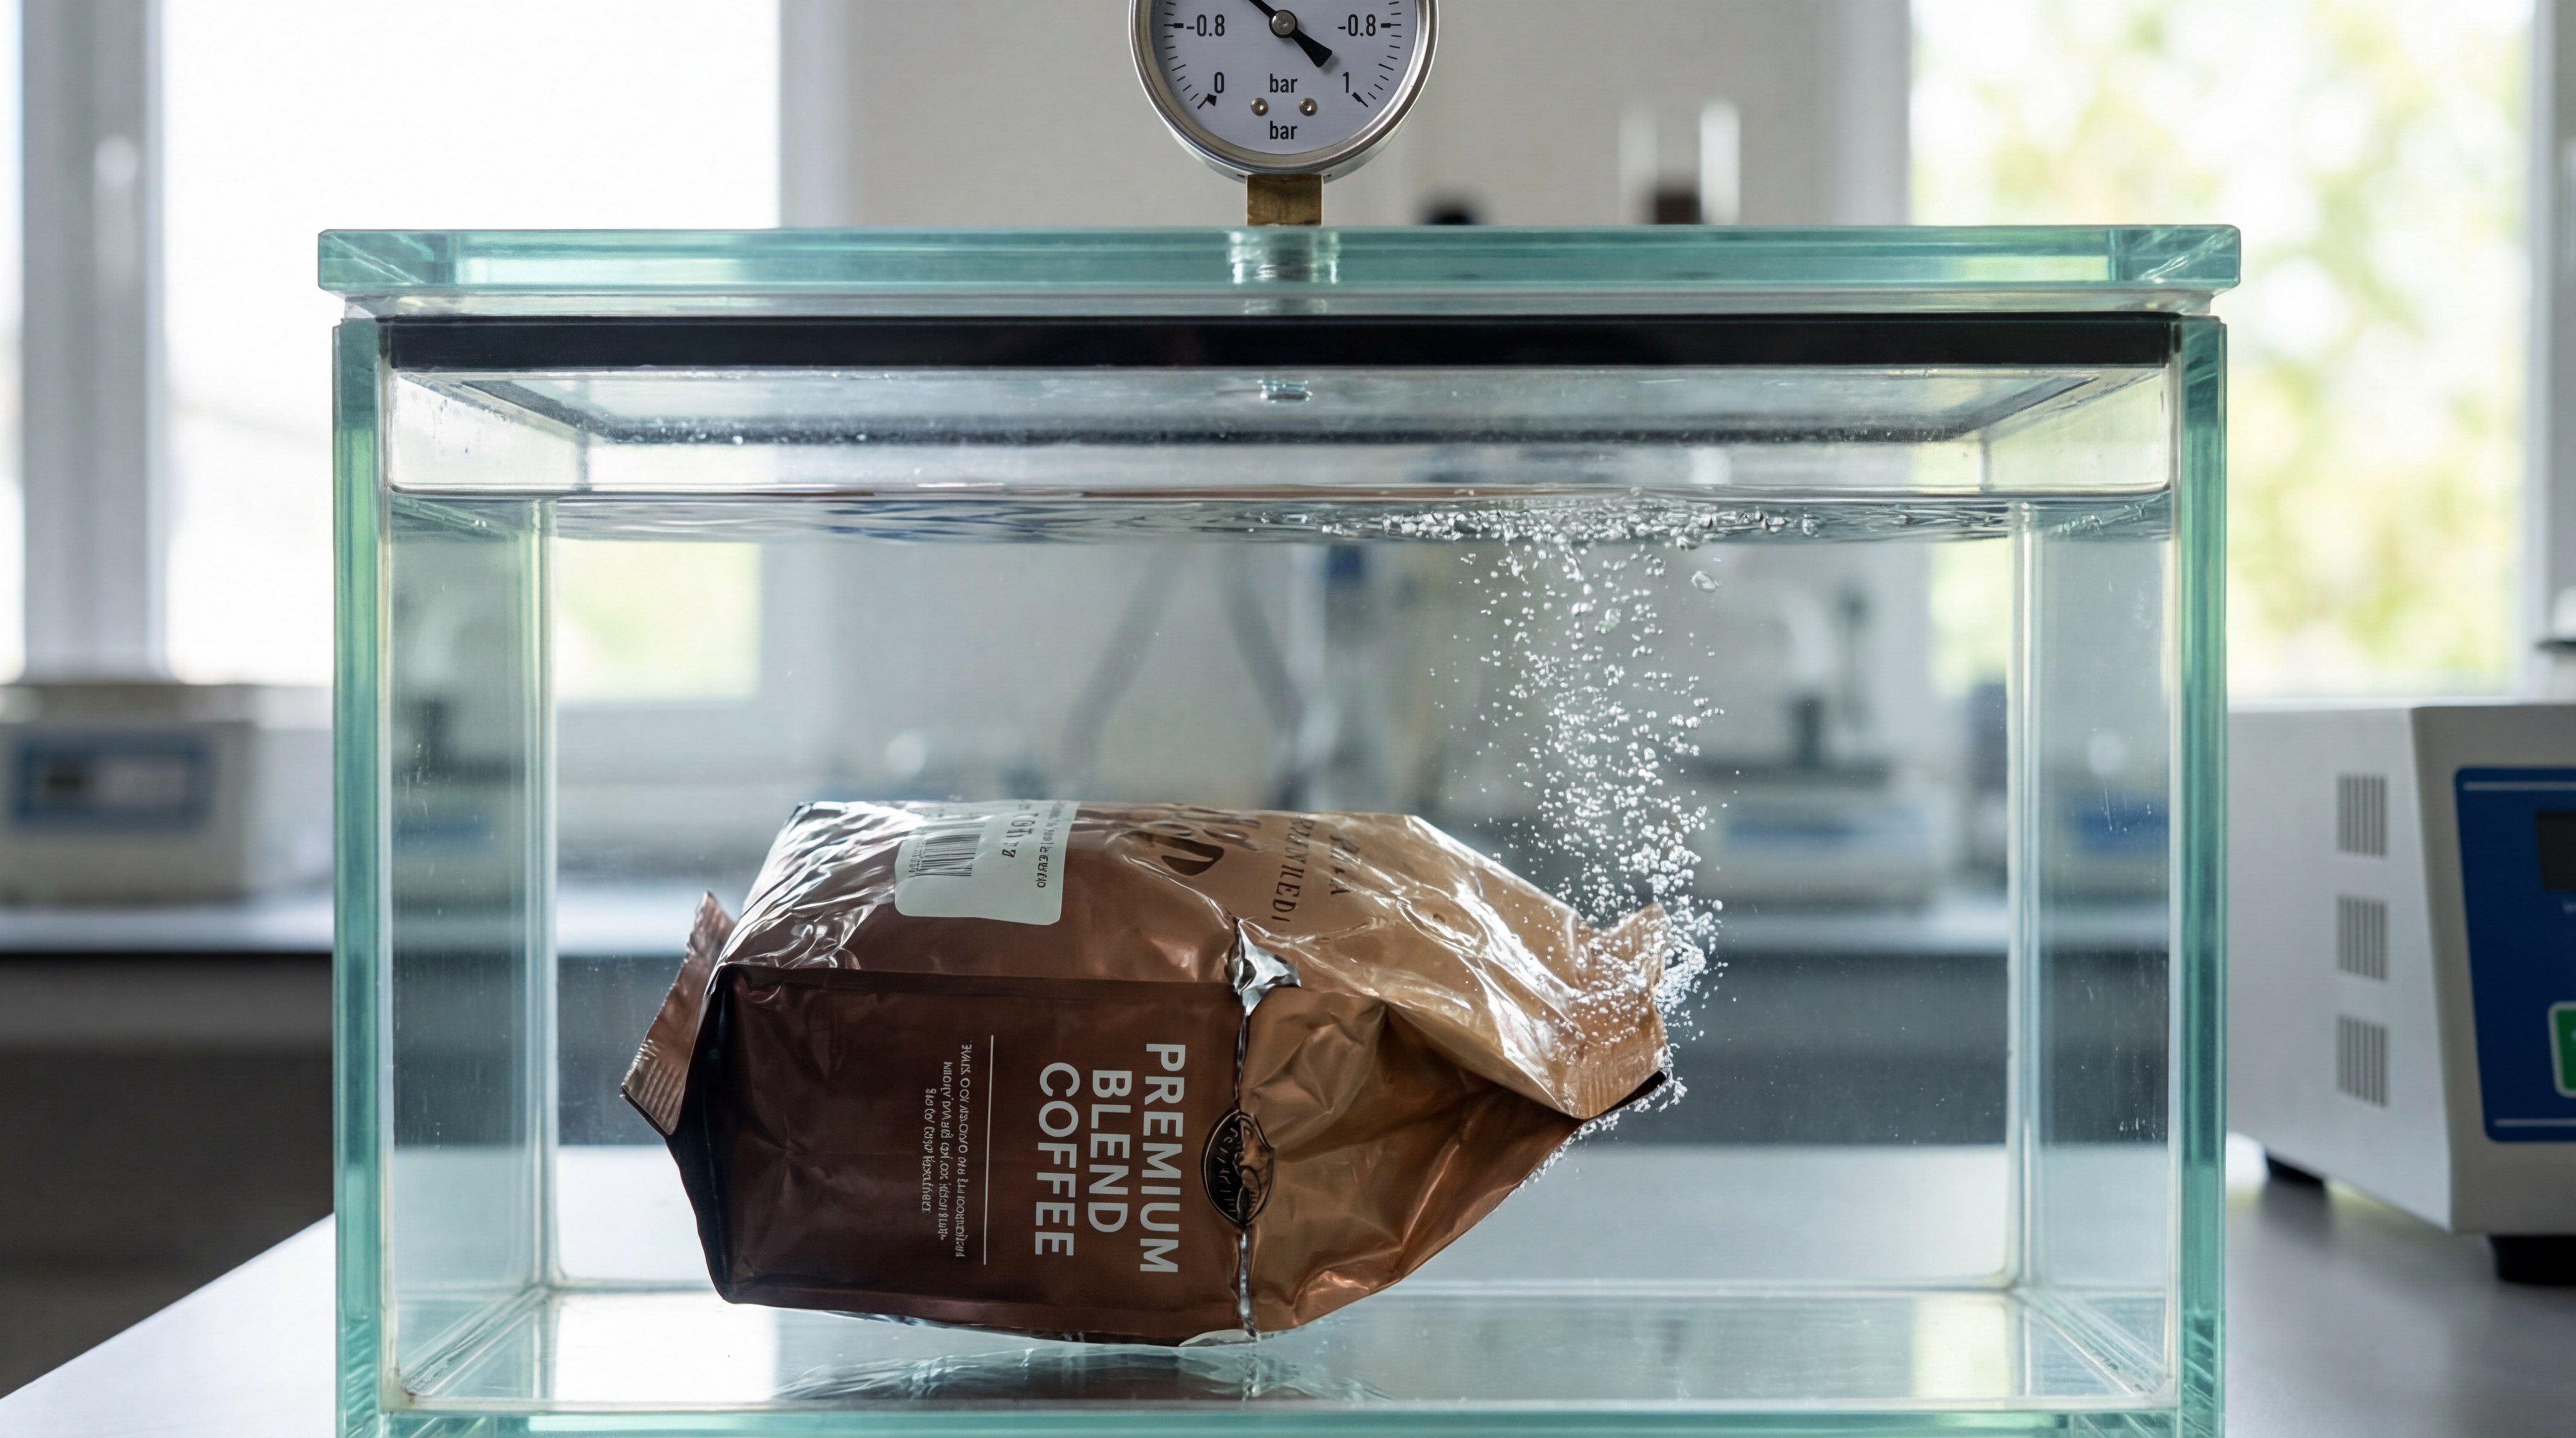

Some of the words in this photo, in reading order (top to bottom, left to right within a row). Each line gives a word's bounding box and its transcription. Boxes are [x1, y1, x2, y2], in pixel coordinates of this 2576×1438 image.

[1186, 14, 1225, 37] -0.8
[1337, 14, 1376, 37] -0.8
[1214, 72, 1225, 94] 0
[1269, 73, 1298, 93] bar
[1342, 72, 1350, 93] 1
[1269, 120, 1298, 140] bar
[1035, 1062, 1080, 1256] COFFEE
[1087, 1069, 1133, 1233] BLEND
[1139, 1043, 1186, 1273] PREMIUM
